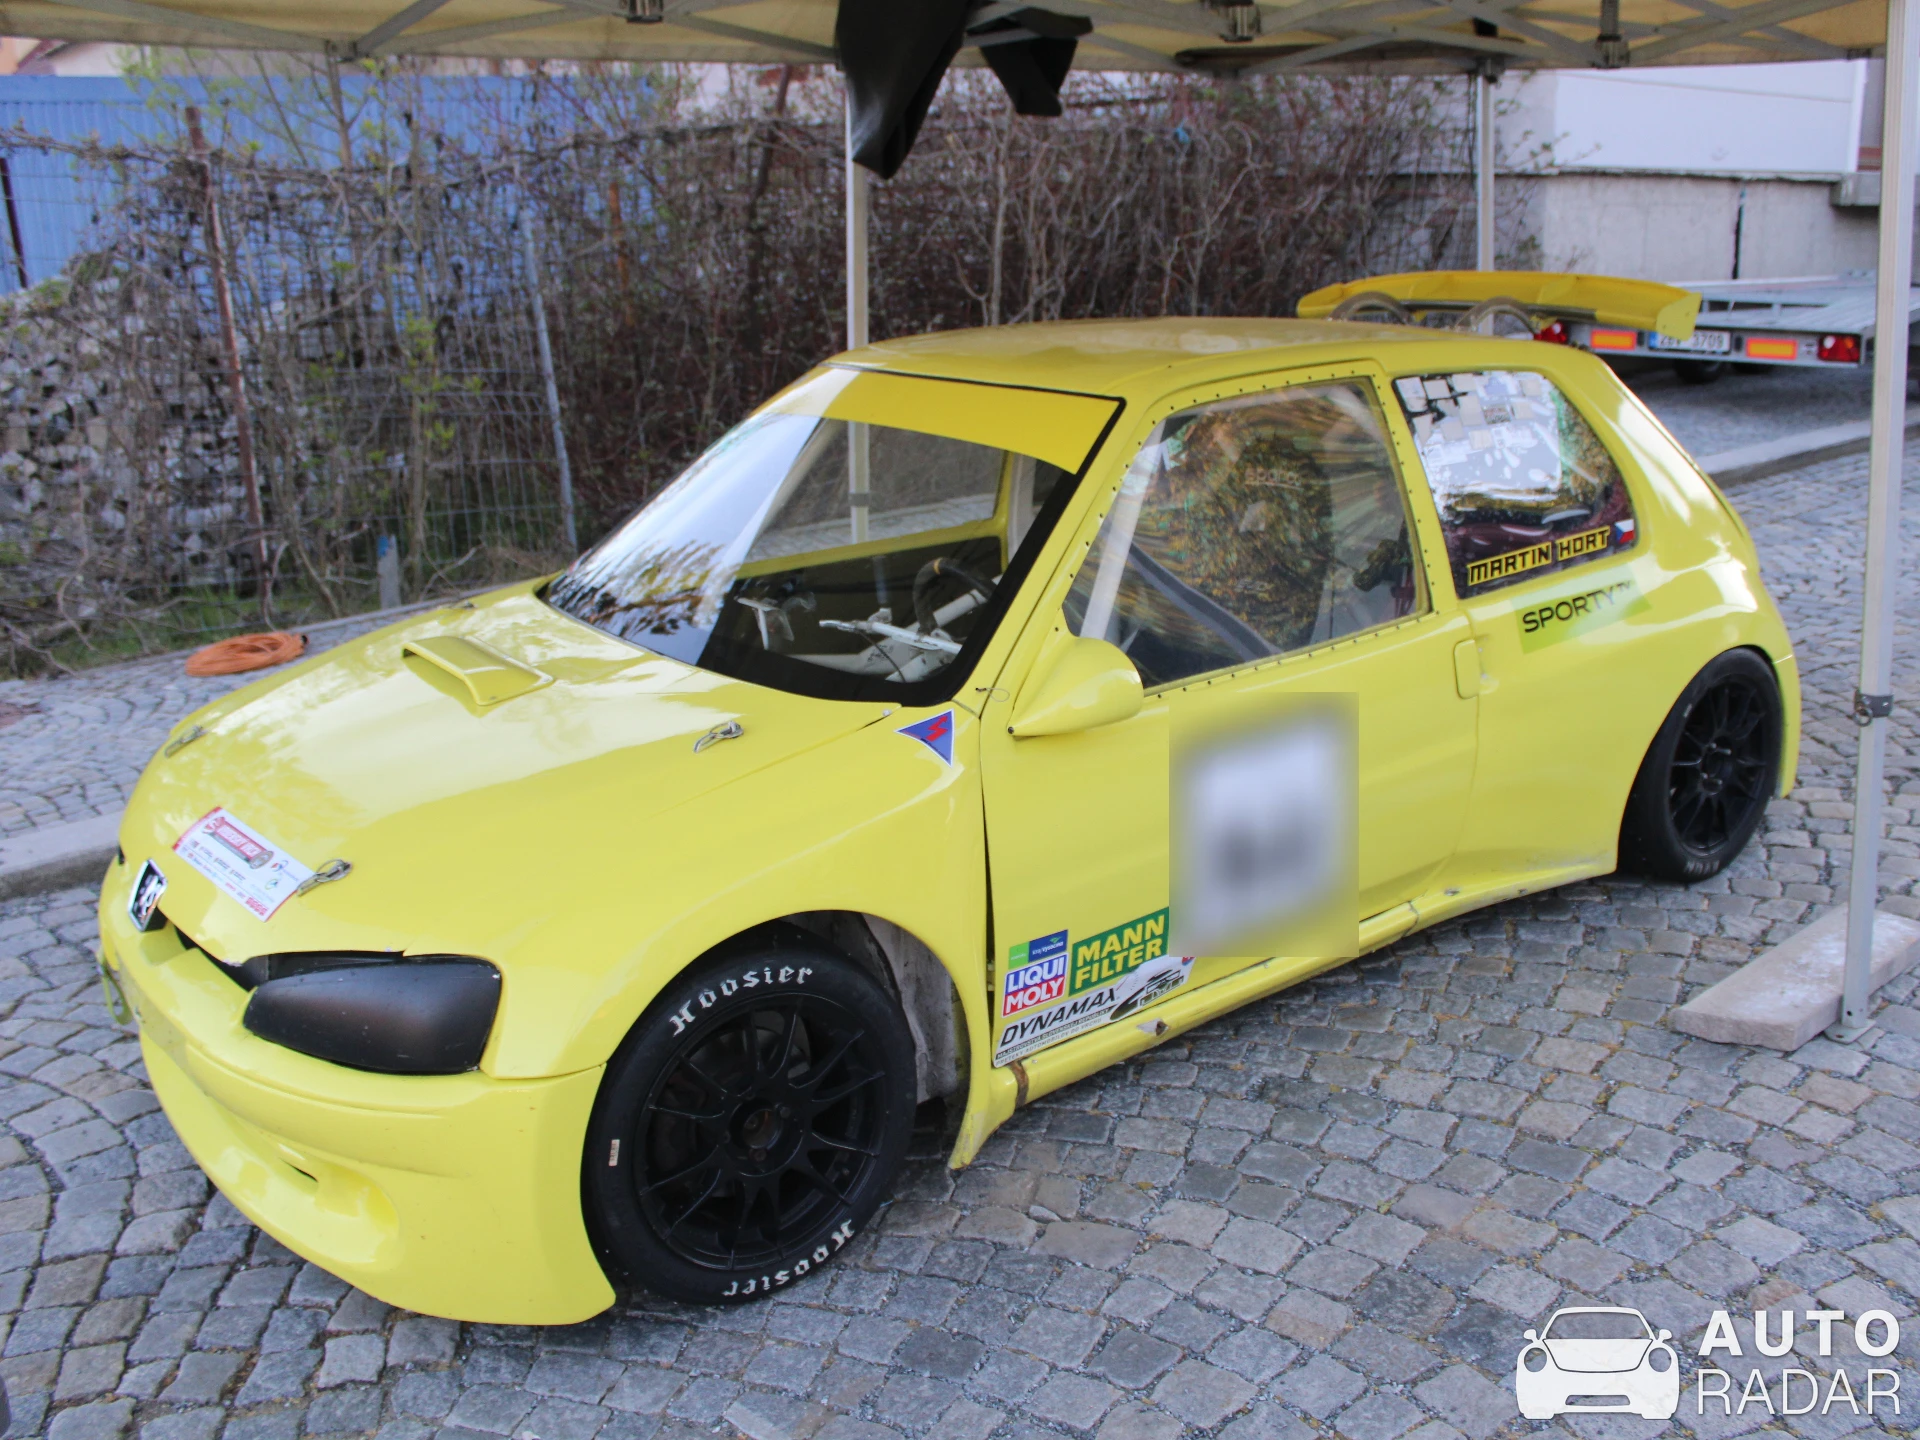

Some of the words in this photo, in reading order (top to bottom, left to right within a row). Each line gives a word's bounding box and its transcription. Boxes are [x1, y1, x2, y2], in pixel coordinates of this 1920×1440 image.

[1470, 543, 1550, 584] MARTIN
[1559, 529, 1609, 559] HORT
[1522, 585, 1616, 633] SPORTY
[1074, 938, 1163, 990] FILTER
[1076, 915, 1165, 967] MANN
[669, 964, 814, 1038] Hoosier
[1005, 977, 1065, 1014] MOLY
[1007, 957, 1066, 993] LIQUI
[1000, 988, 1115, 1047] DYNAMAX
[724, 1219, 855, 1297] Hoosier
